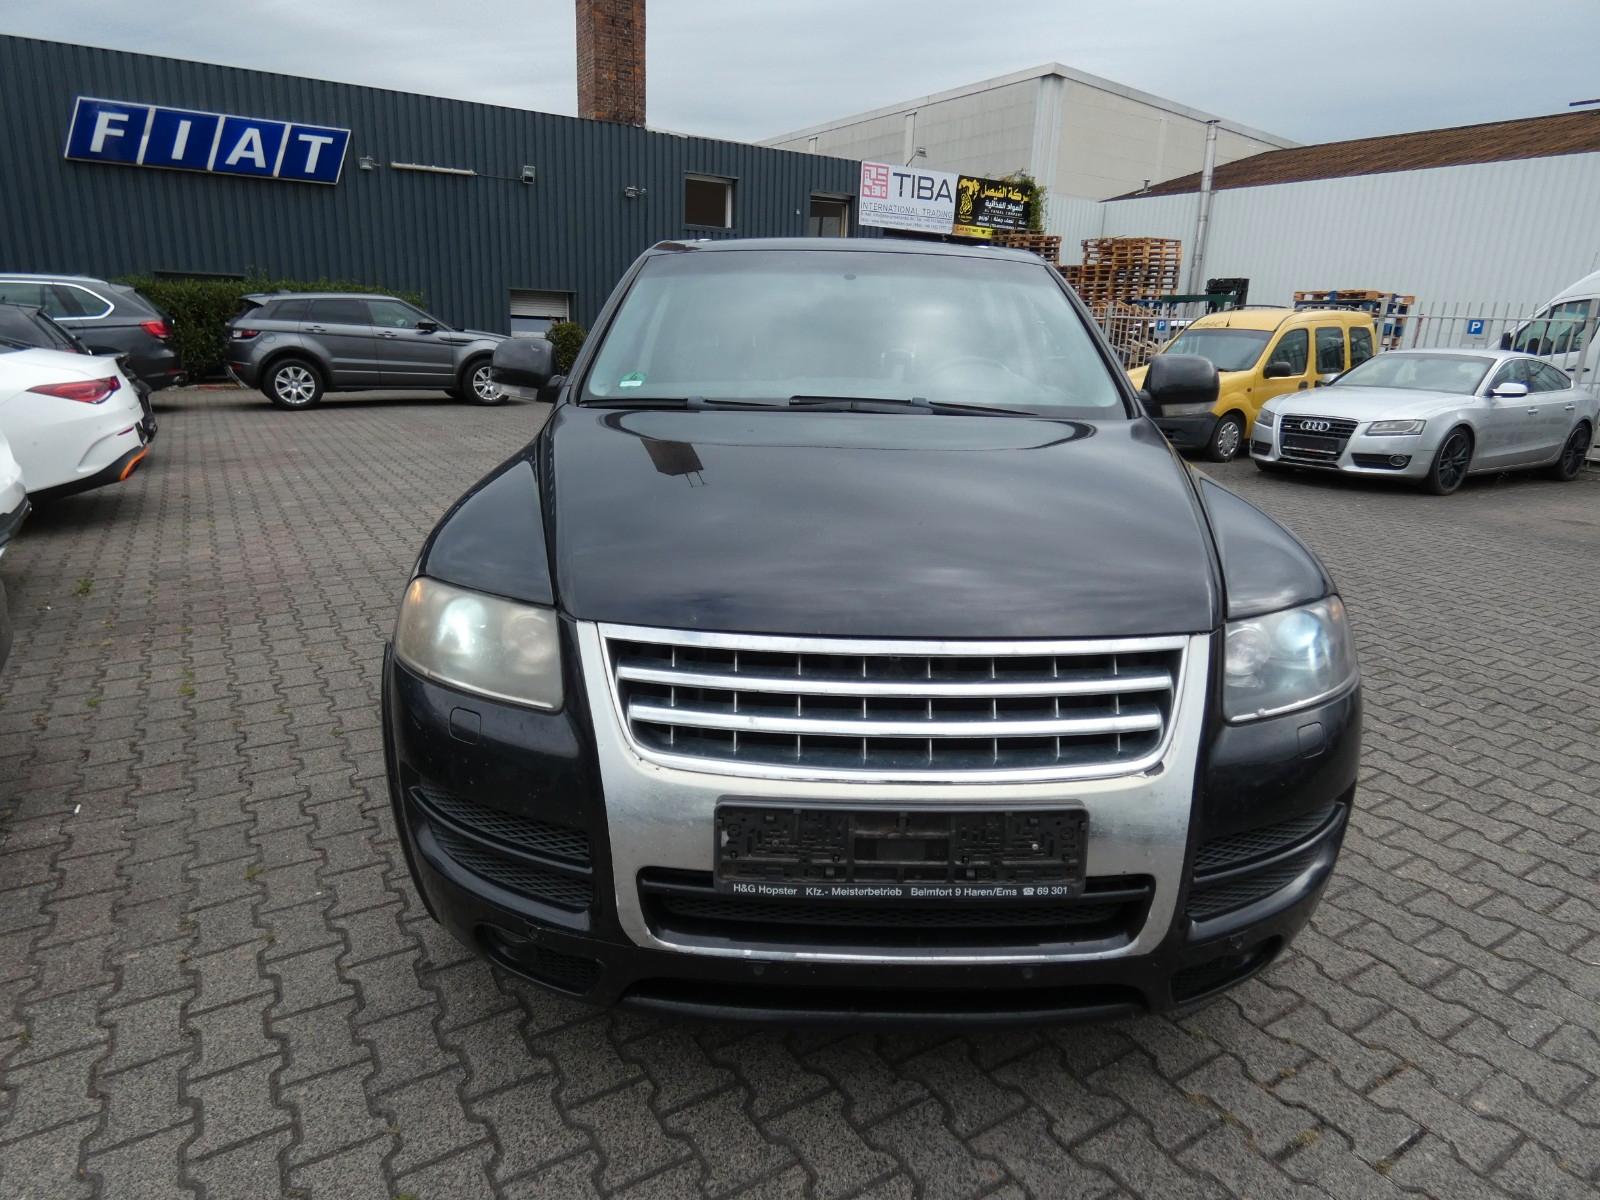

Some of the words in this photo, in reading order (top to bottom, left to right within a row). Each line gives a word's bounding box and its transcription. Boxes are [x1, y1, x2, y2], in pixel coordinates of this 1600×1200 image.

[90, 111, 333, 174] FIAT
[892, 172, 953, 203] TIBA
[980, 184, 1007, 200] الفيصل
[861, 202, 918, 215] INTERNATIONAL
[922, 207, 953, 219] TRADING
[1470, 321, 1481, 333] P
[733, 883, 756, 893] H&G
[758, 885, 798, 896] Hopster
[831, 887, 902, 896] Meisterbetrieb
[955, 888, 962, 896] 9
[964, 887, 1017, 897] Haren/Ems
[1036, 887, 1049, 896] 69
[1051, 886, 1068, 895] 301
